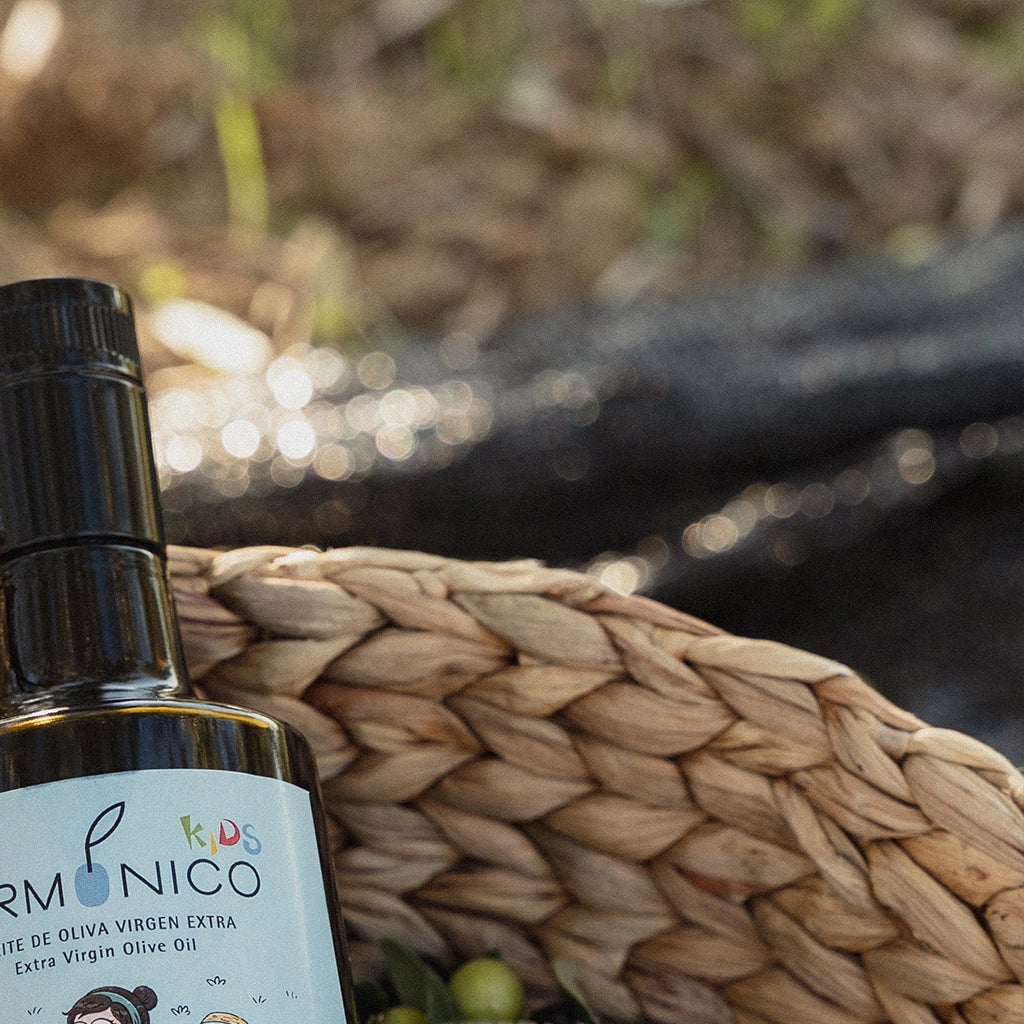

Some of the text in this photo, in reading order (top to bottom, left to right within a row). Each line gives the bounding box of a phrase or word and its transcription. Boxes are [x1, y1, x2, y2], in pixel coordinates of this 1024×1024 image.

[31, 932, 51, 948] DE
[59, 923, 109, 942] OLIVA
[115, 916, 179, 933] VIRGEN
[187, 915, 236, 929] EXTRA
[15, 938, 196, 975] Extra Virgin Olive Oil
